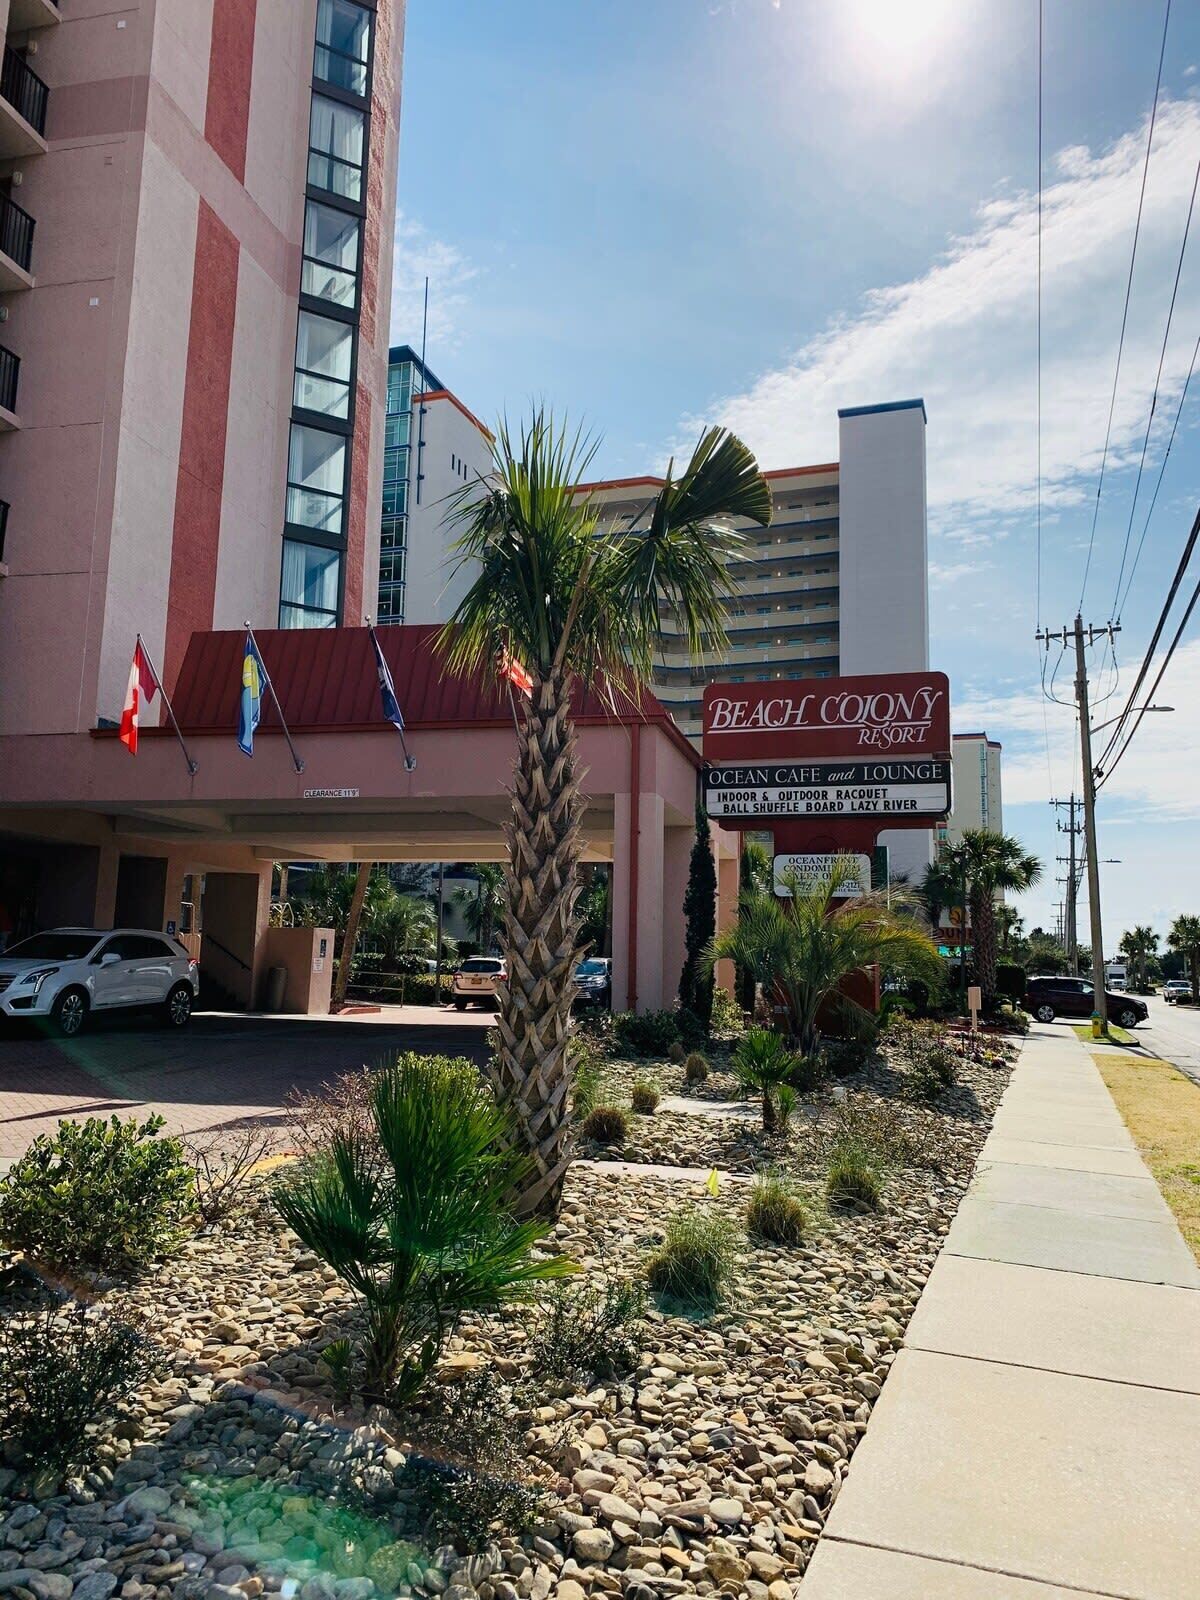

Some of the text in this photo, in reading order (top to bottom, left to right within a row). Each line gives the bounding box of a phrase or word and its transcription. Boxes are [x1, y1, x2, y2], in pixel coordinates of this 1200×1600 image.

[708, 687, 943, 729] BEACH COLONY
[857, 725, 927, 749] RESORT
[708, 764, 943, 785] OCEAN CAFE and LOUNGE
[717, 788, 888, 802] INDOOR & OUTDOOR RACQUET
[723, 799, 917, 813] BALL SHUFFLE BOARD LAZY RIVER
